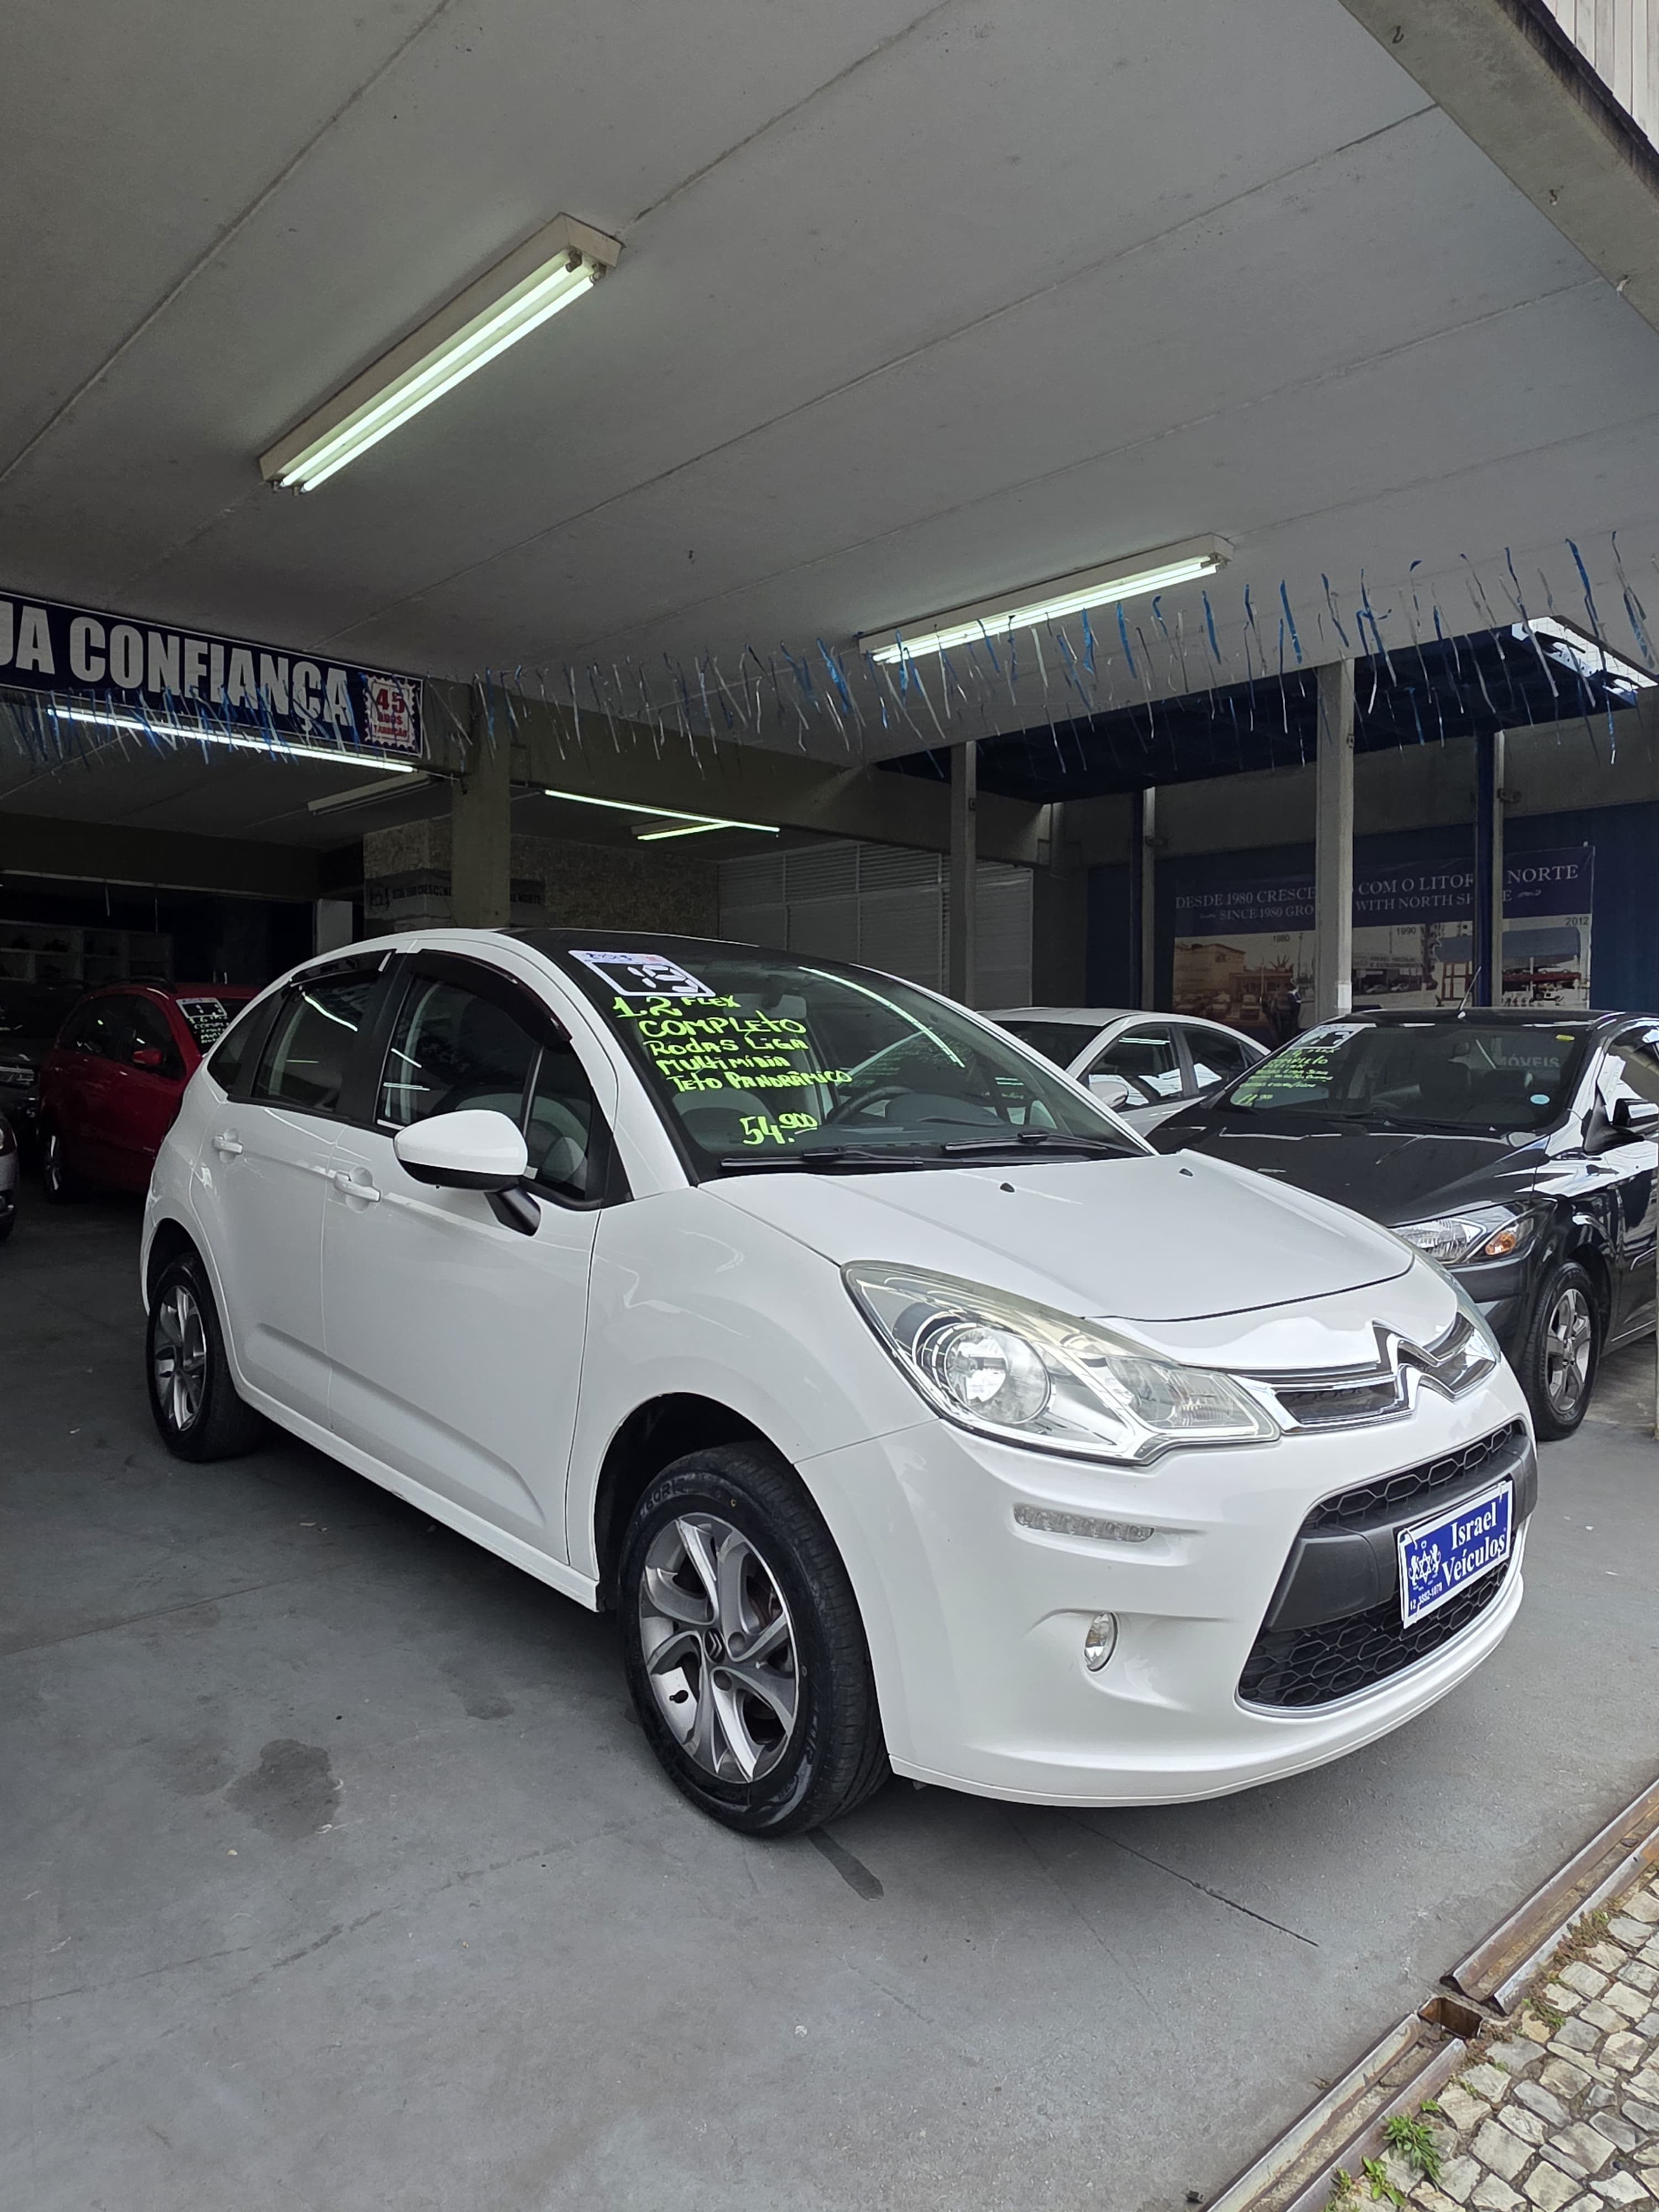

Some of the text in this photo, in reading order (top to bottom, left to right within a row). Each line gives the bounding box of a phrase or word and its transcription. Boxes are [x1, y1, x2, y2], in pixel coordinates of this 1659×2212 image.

[70, 616, 353, 731] CONFIANÇA
[377, 687, 405, 713] 45
[1175, 894, 1223, 909] DESDE
[1227, 892, 1253, 905] 1980
[1358, 879, 1397, 895] COM
[1402, 878, 1415, 891] O
[1507, 864, 1579, 885] NORTE
[1219, 910, 1257, 921] SINCE
[1260, 907, 1283, 919] 1980
[1355, 899, 1395, 911] WITH
[1399, 893, 1453, 909] NORTH
[1564, 916, 1589, 926] 2012
[1272, 933, 1290, 942] 1980
[1396, 926, 1416, 936] 1990
[613, 995, 741, 1018] 1.2 FLEX
[639, 1010, 806, 1038] COMPLETO
[1451, 1501, 1496, 1551] Israel
[1442, 1533, 1505, 1587] Veículos
